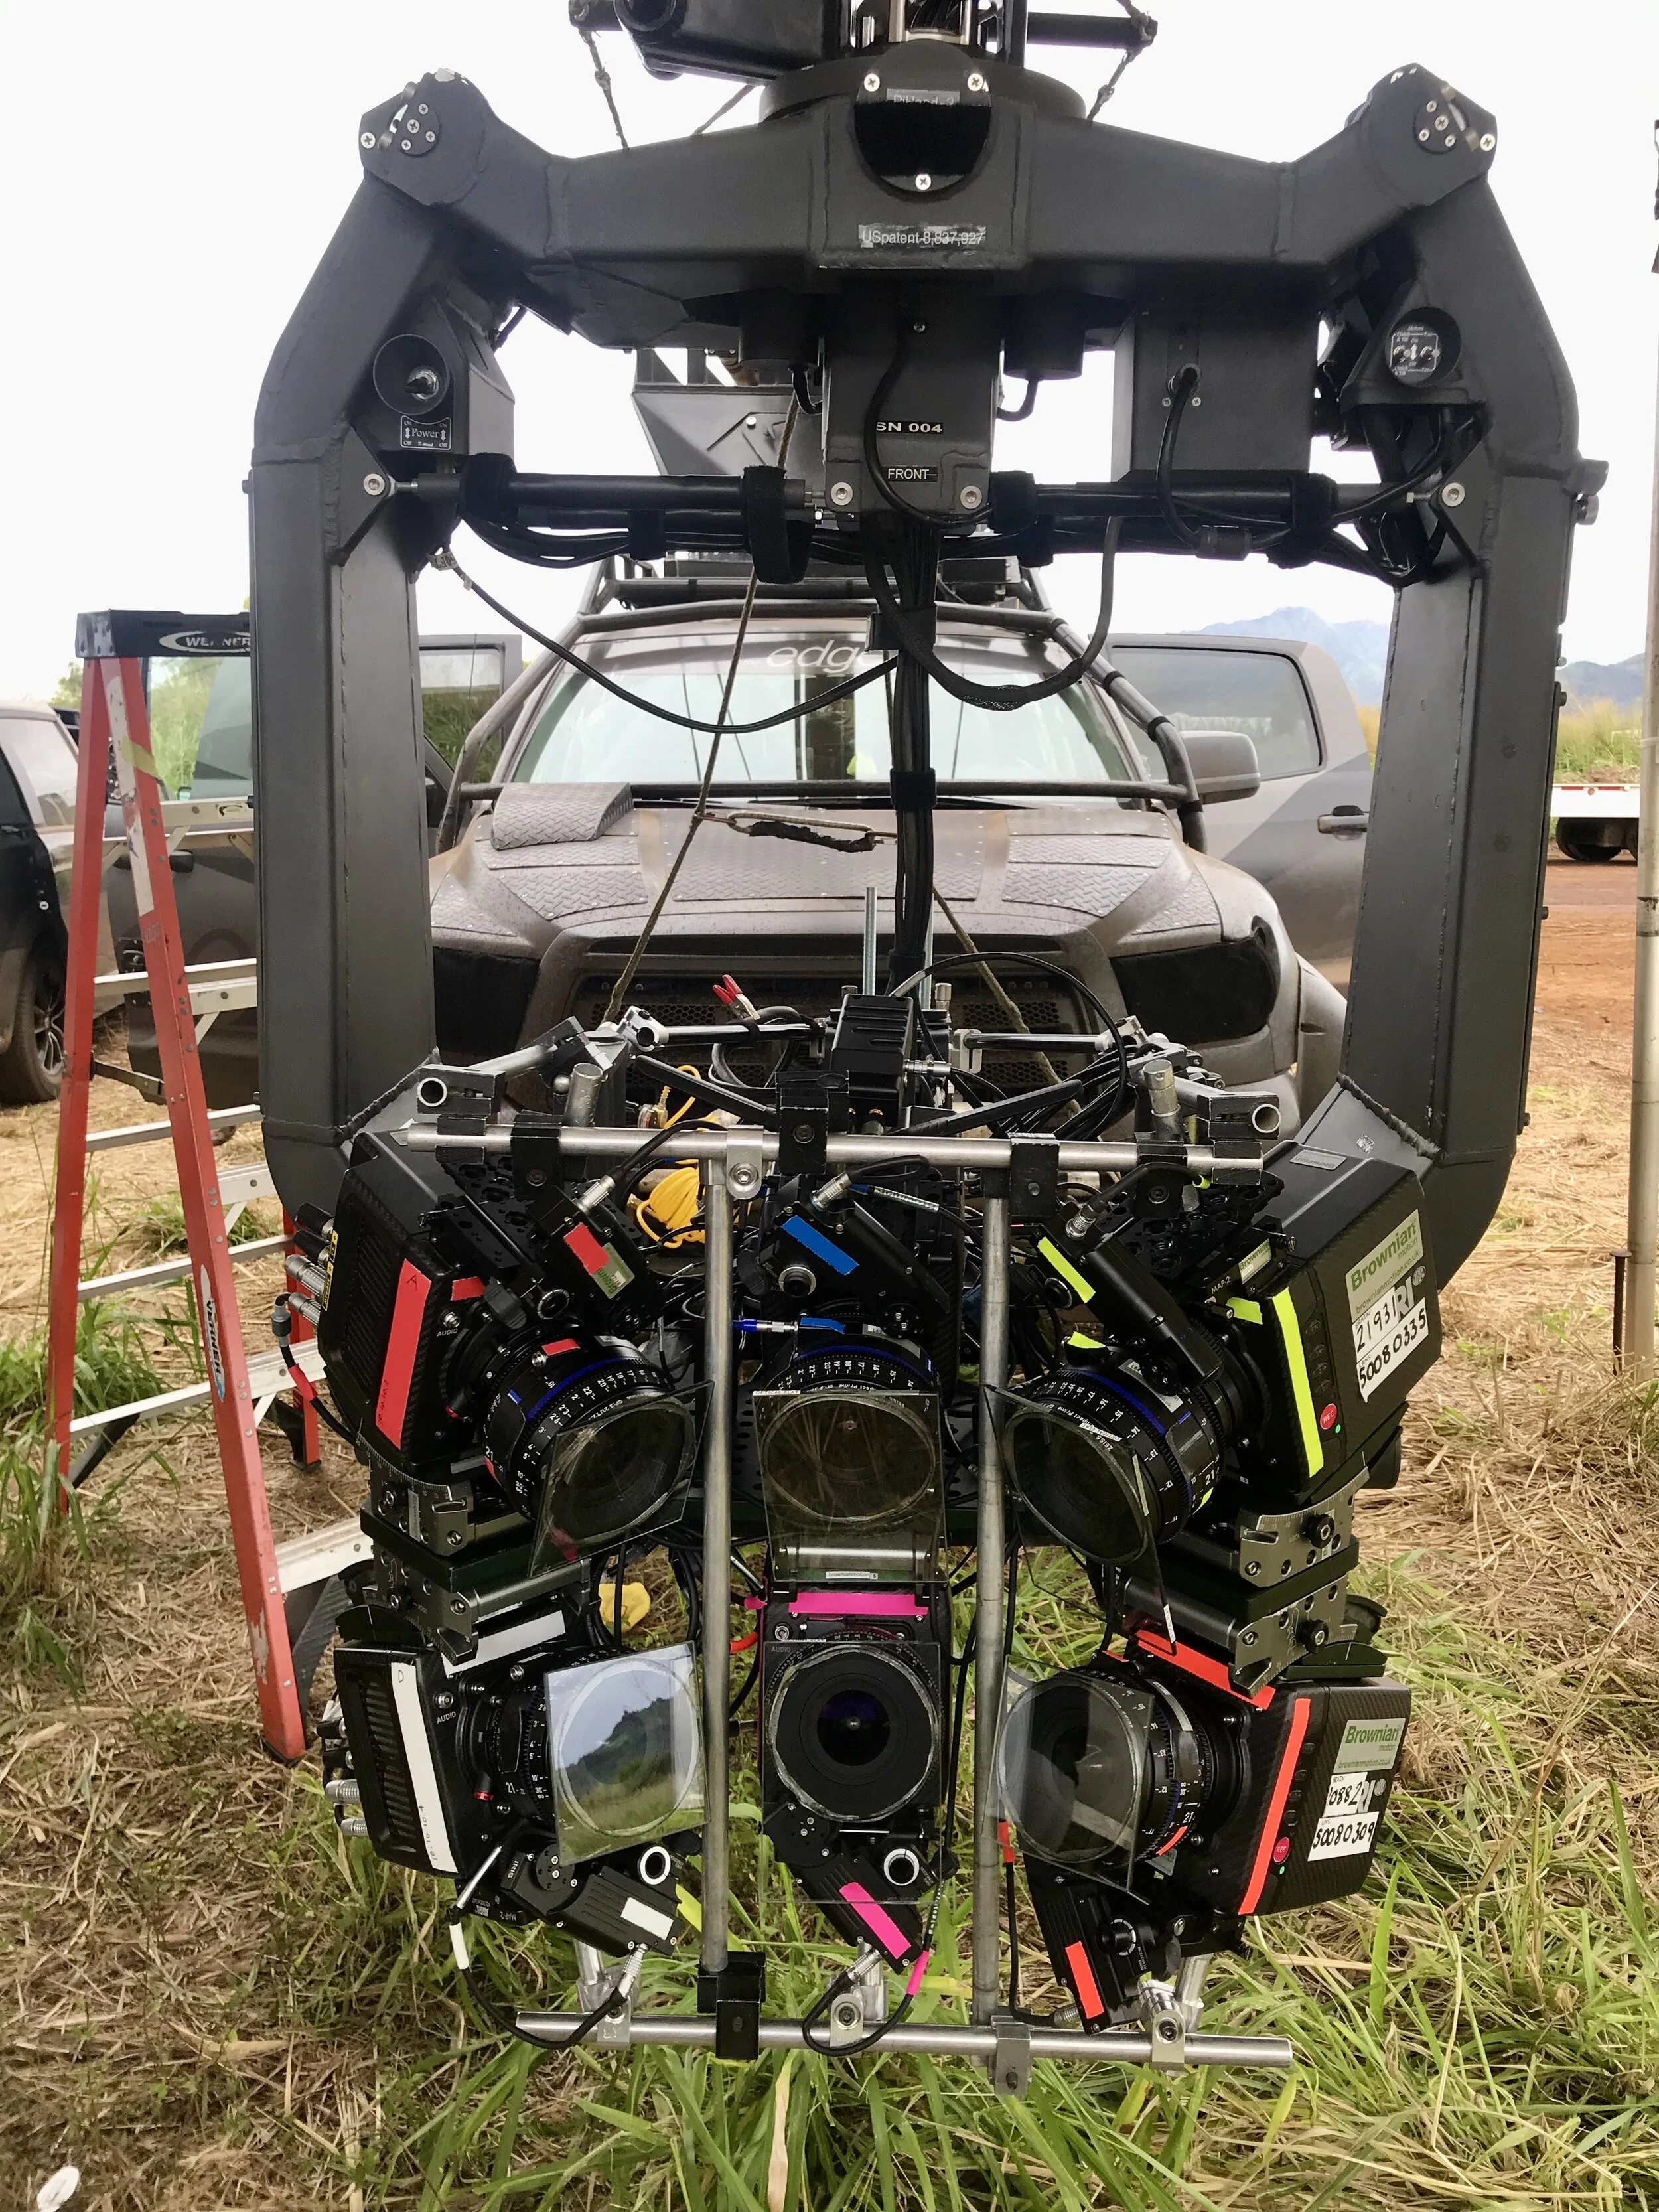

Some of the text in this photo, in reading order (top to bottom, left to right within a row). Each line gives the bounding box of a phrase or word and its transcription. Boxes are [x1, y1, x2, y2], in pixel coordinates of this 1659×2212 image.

[411, 428, 440, 438] Power
[876, 421, 943, 433] SN 004
[887, 468, 930, 479] FRONT
[186, 636, 251, 648] WENER
[1350, 1222, 1417, 1291] Brownian
[1398, 1237, 1418, 1260] motion
[1356, 1251, 1421, 1314] brownianmotion.co.uk
[436, 1327, 459, 1337] AUDIO
[1356, 1295, 1397, 1353] 21931
[1358, 1307, 1427, 1389] 50080335
[1323, 1410, 1335, 1424] REC
[1096, 1435, 1114, 1451] ZEISS
[1205, 1469, 1216, 1486] 21
[398, 1669, 405, 1684] D
[437, 1710, 457, 1724] AUDIO
[1345, 1724, 1399, 1744] Brownian
[1313, 1821, 1376, 1849] 50080309
[508, 1860, 519, 1879] IRIS
